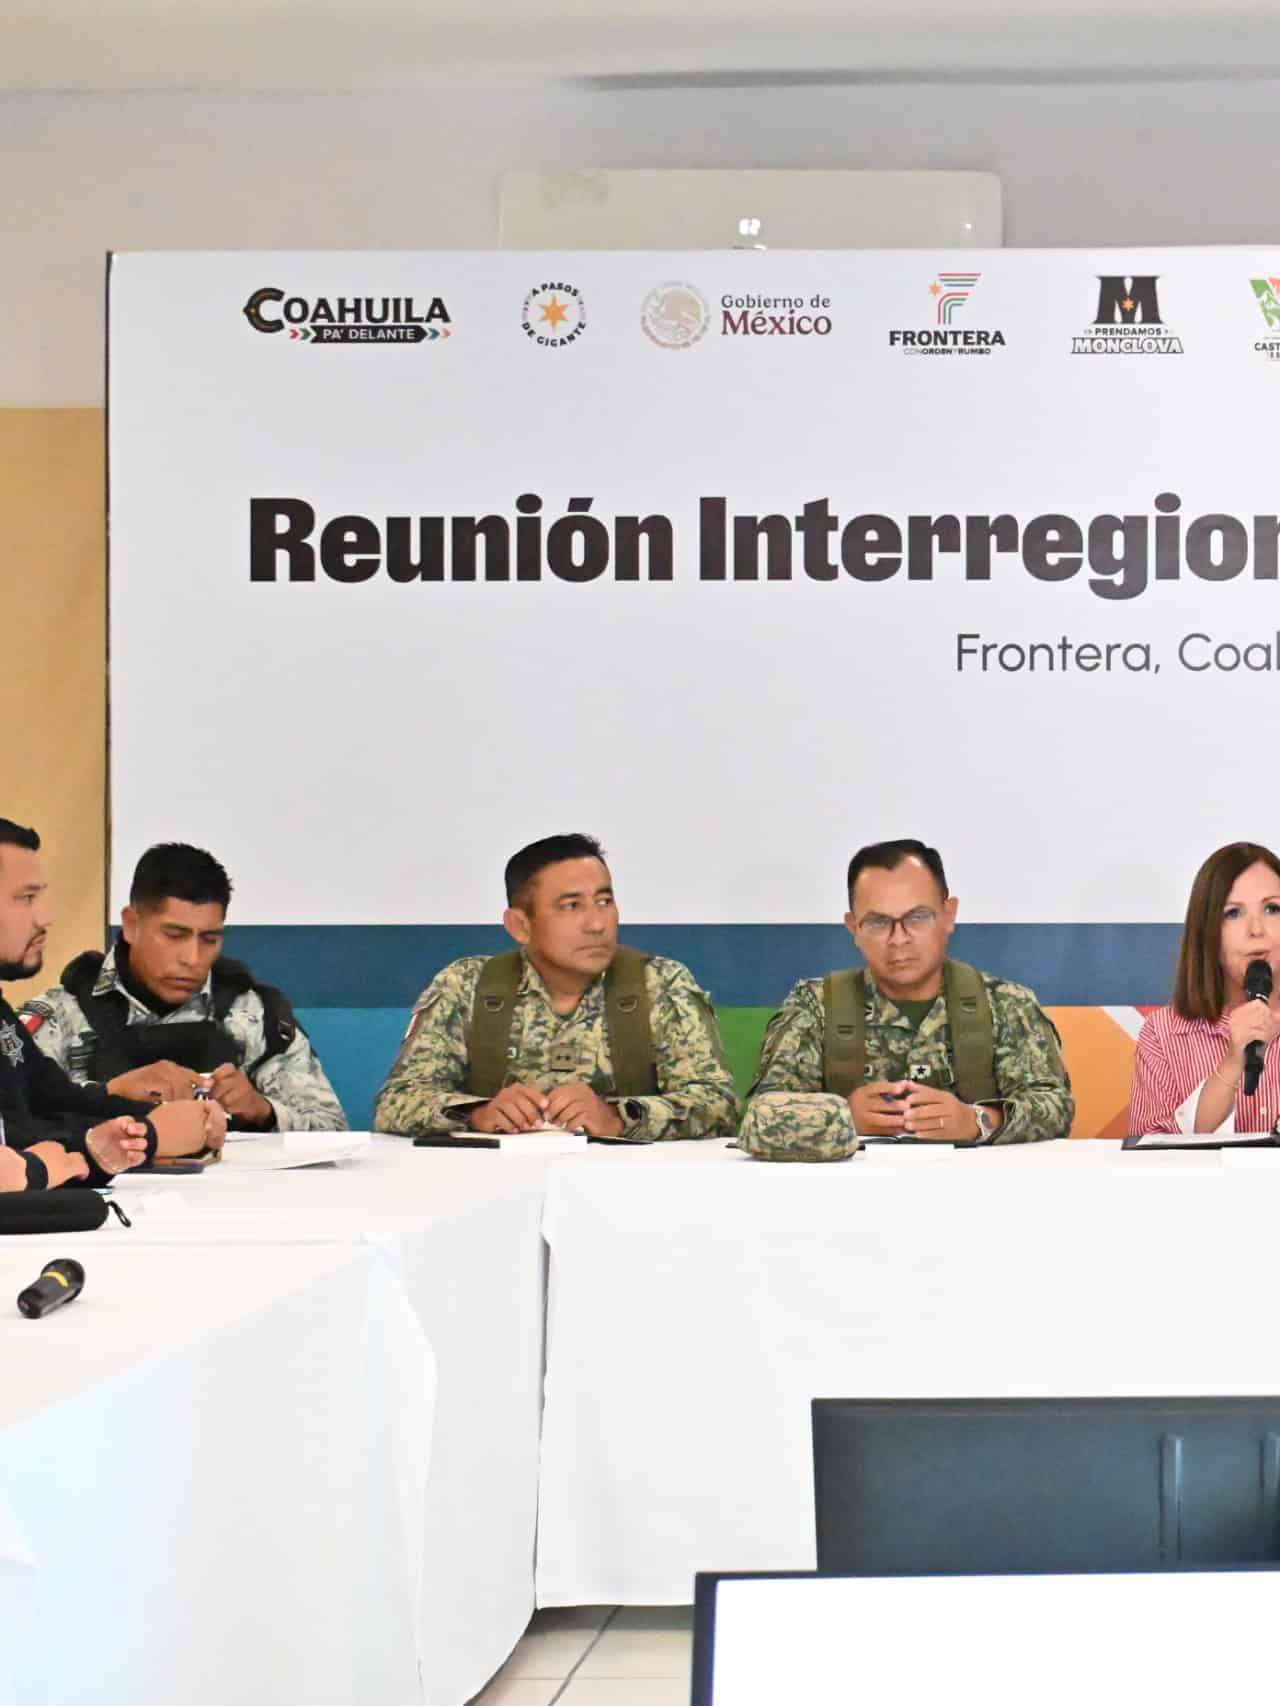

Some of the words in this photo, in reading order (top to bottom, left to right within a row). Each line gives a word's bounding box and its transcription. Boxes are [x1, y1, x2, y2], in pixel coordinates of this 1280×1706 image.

[532, 287, 540, 297] A
[541, 282, 579, 297] PASOS
[243, 287, 452, 333] COAHUILA
[721, 294, 805, 309] Gobierno
[810, 294, 831, 309] de
[720, 309, 832, 336] México
[349, 329, 416, 340] DELANTE
[521, 321, 537, 338] DE
[536, 321, 587, 348] GIGANTE
[888, 330, 1006, 346] FRONTERA
[1094, 327, 1162, 336] PRENDAMOS
[1071, 337, 1185, 354] MONCLOVA
[250, 493, 674, 583] Reunión
[957, 634, 1161, 674] Frontera,
